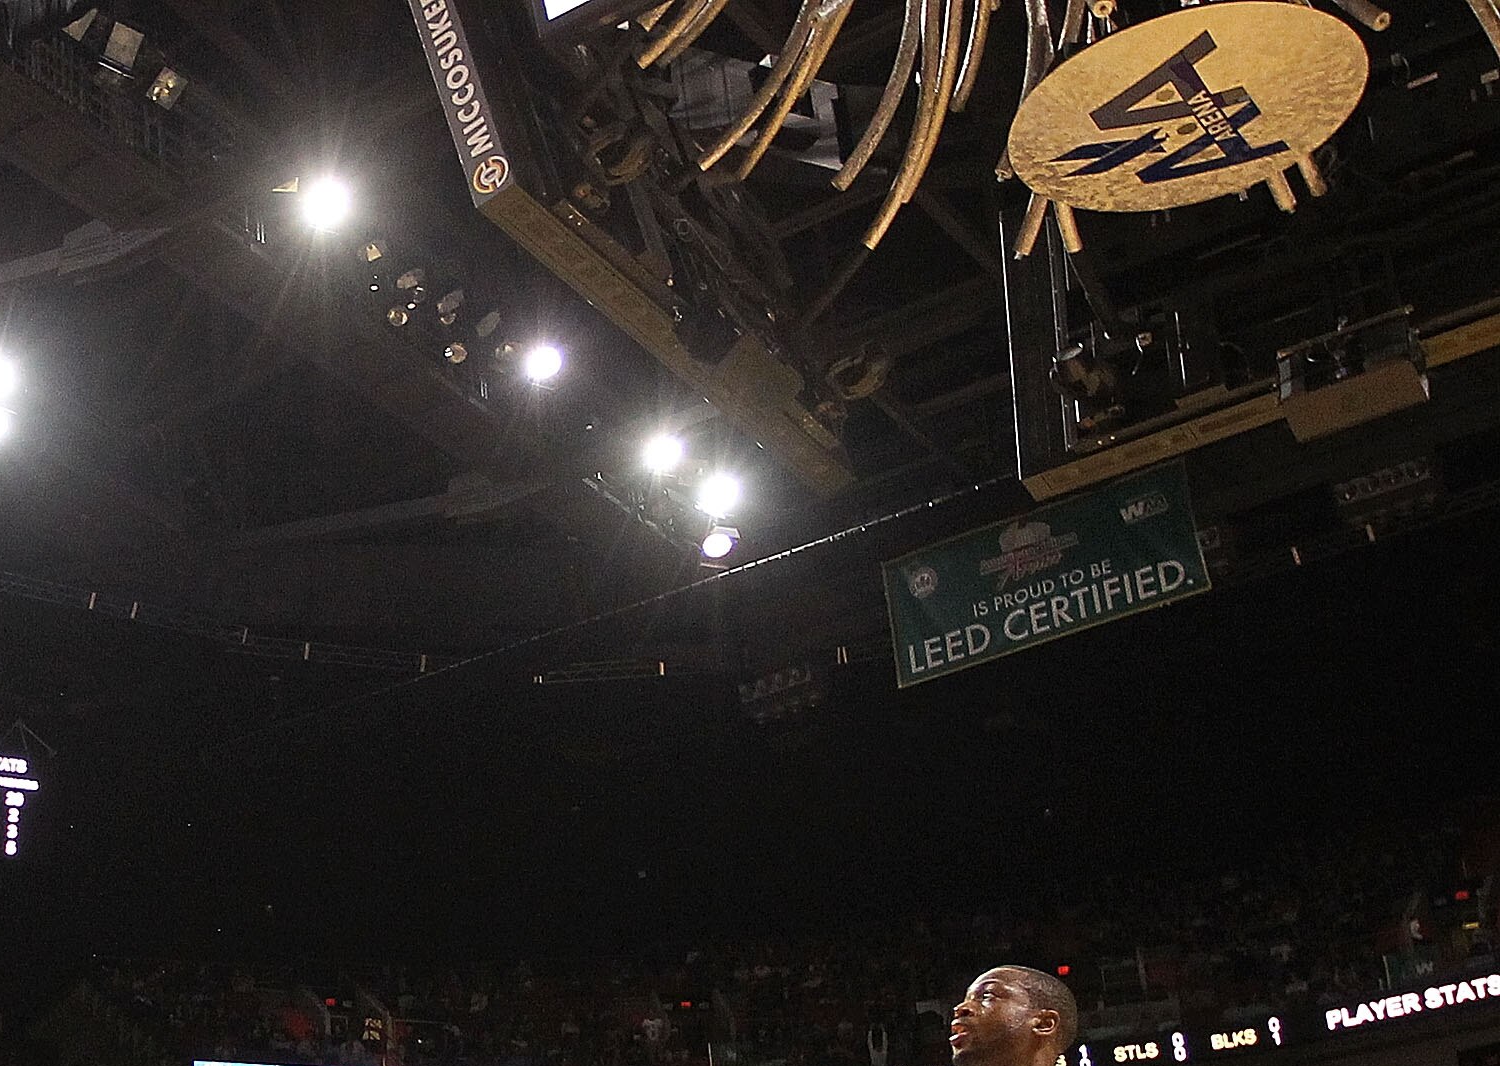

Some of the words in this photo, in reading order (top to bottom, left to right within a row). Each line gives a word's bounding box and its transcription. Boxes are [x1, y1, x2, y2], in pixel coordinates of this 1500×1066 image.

[1188, 89, 1237, 141] ARENA
[908, 623, 991, 673] LEED
[1003, 560, 1195, 641] CERTIFIED.
[973, 602, 988, 617] IS
[994, 579, 1055, 611] PROUD
[1060, 569, 1084, 588] TO
[1091, 559, 1112, 577] BE
[1325, 992, 1422, 1031] PLAYER
[1424, 974, 1500, 1010] STATS
[1113, 1042, 1159, 1062] STLS
[1211, 1028, 1258, 1050] BLKS
[1272, 1031, 1281, 1046] 1
